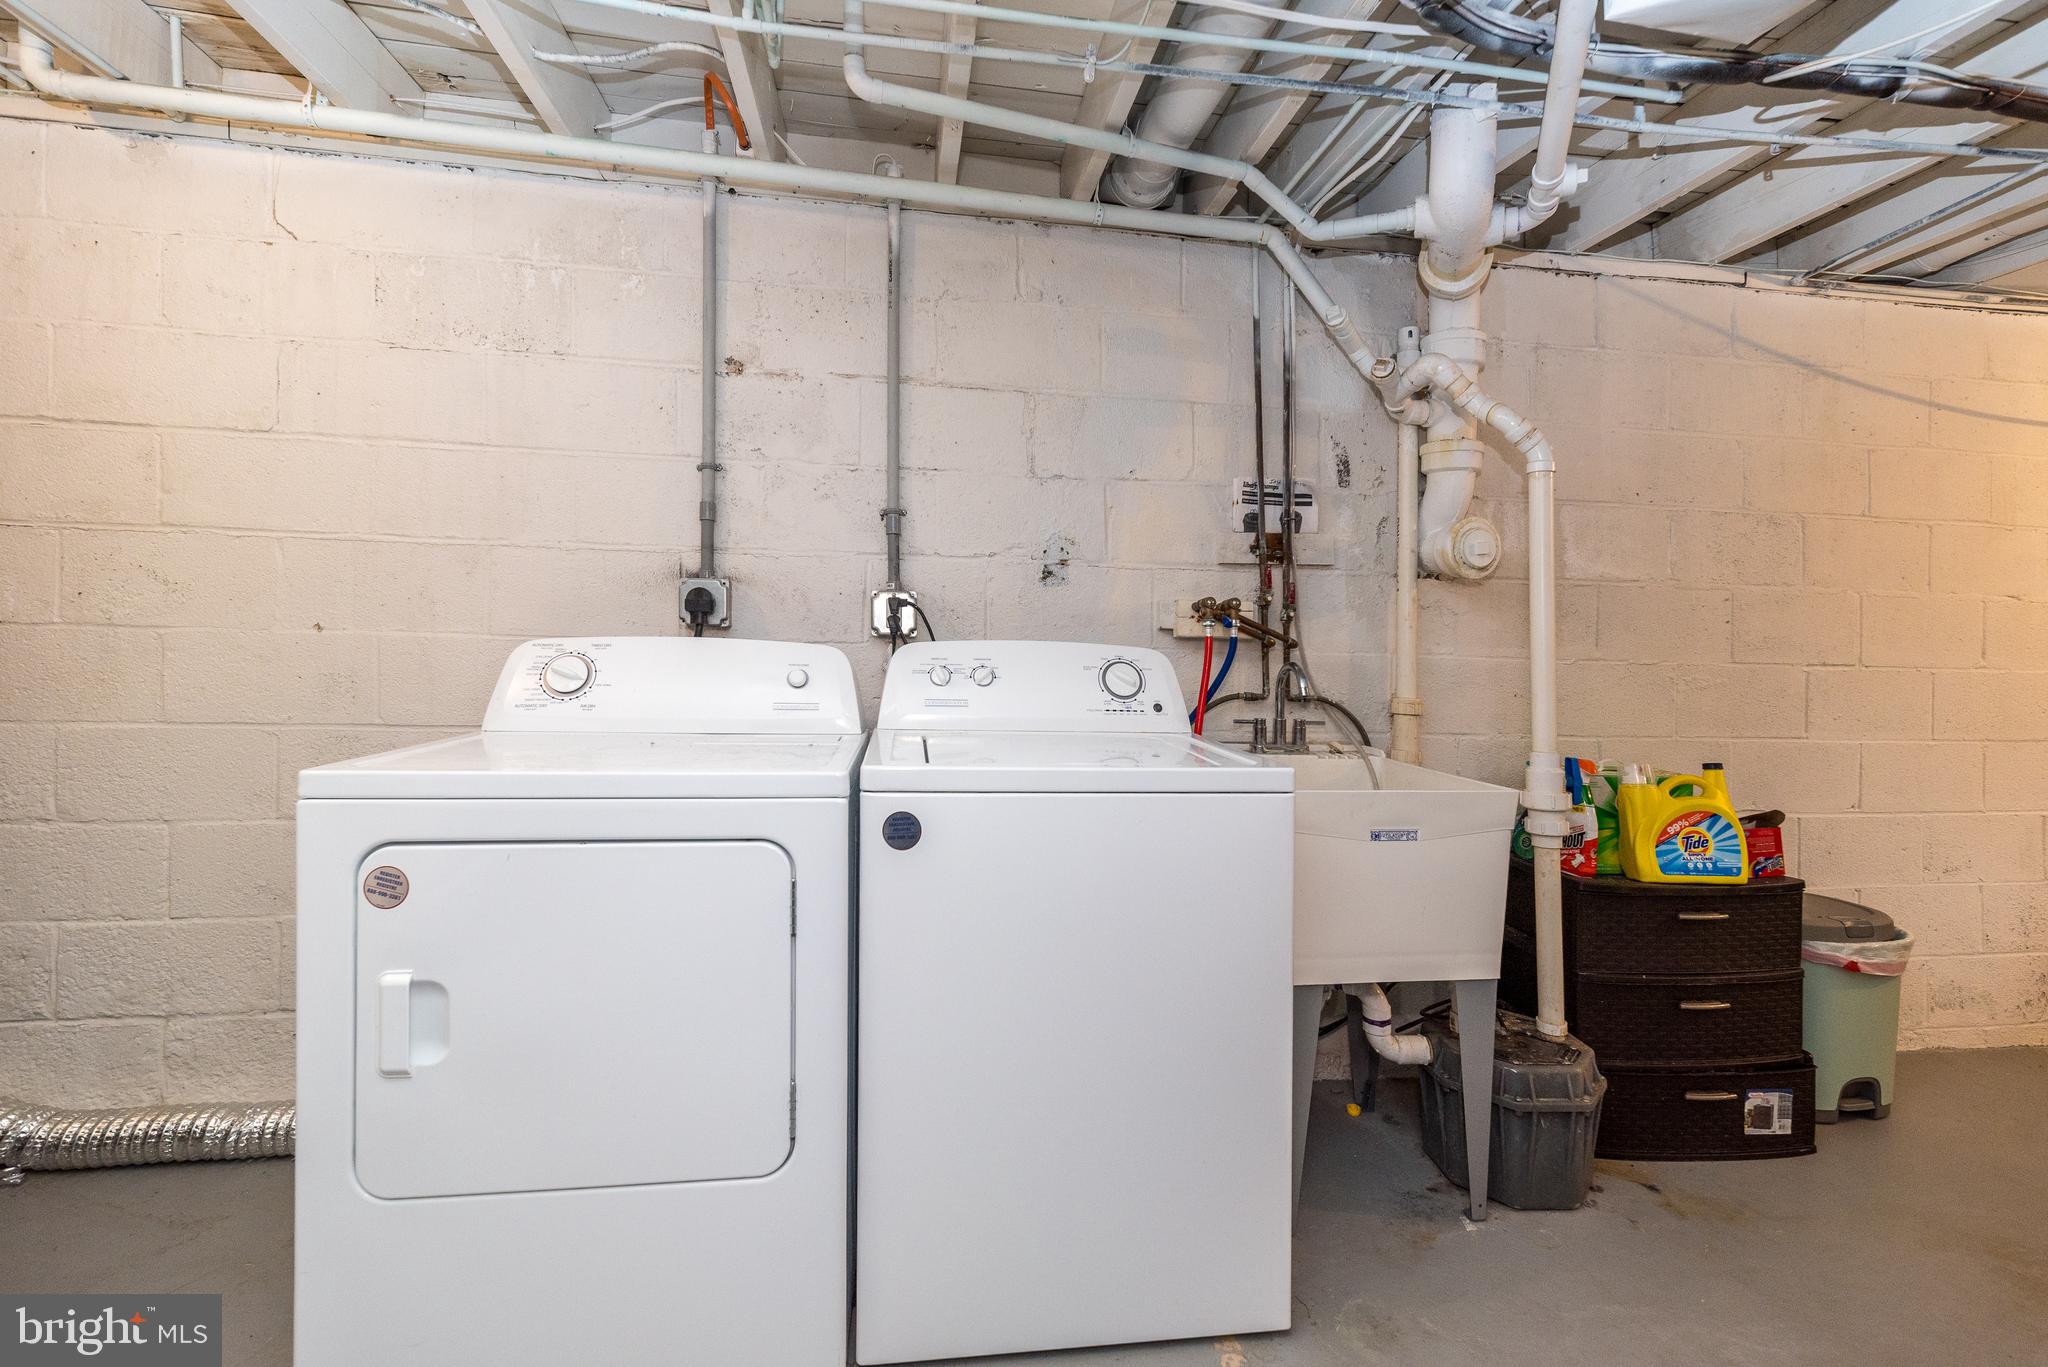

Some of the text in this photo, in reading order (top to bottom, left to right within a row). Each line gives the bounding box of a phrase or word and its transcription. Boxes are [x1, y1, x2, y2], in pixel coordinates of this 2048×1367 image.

[1667, 819, 1690, 835] 99%
[1562, 832, 1586, 848] HOUT
[1682, 835, 1709, 852] Tide
